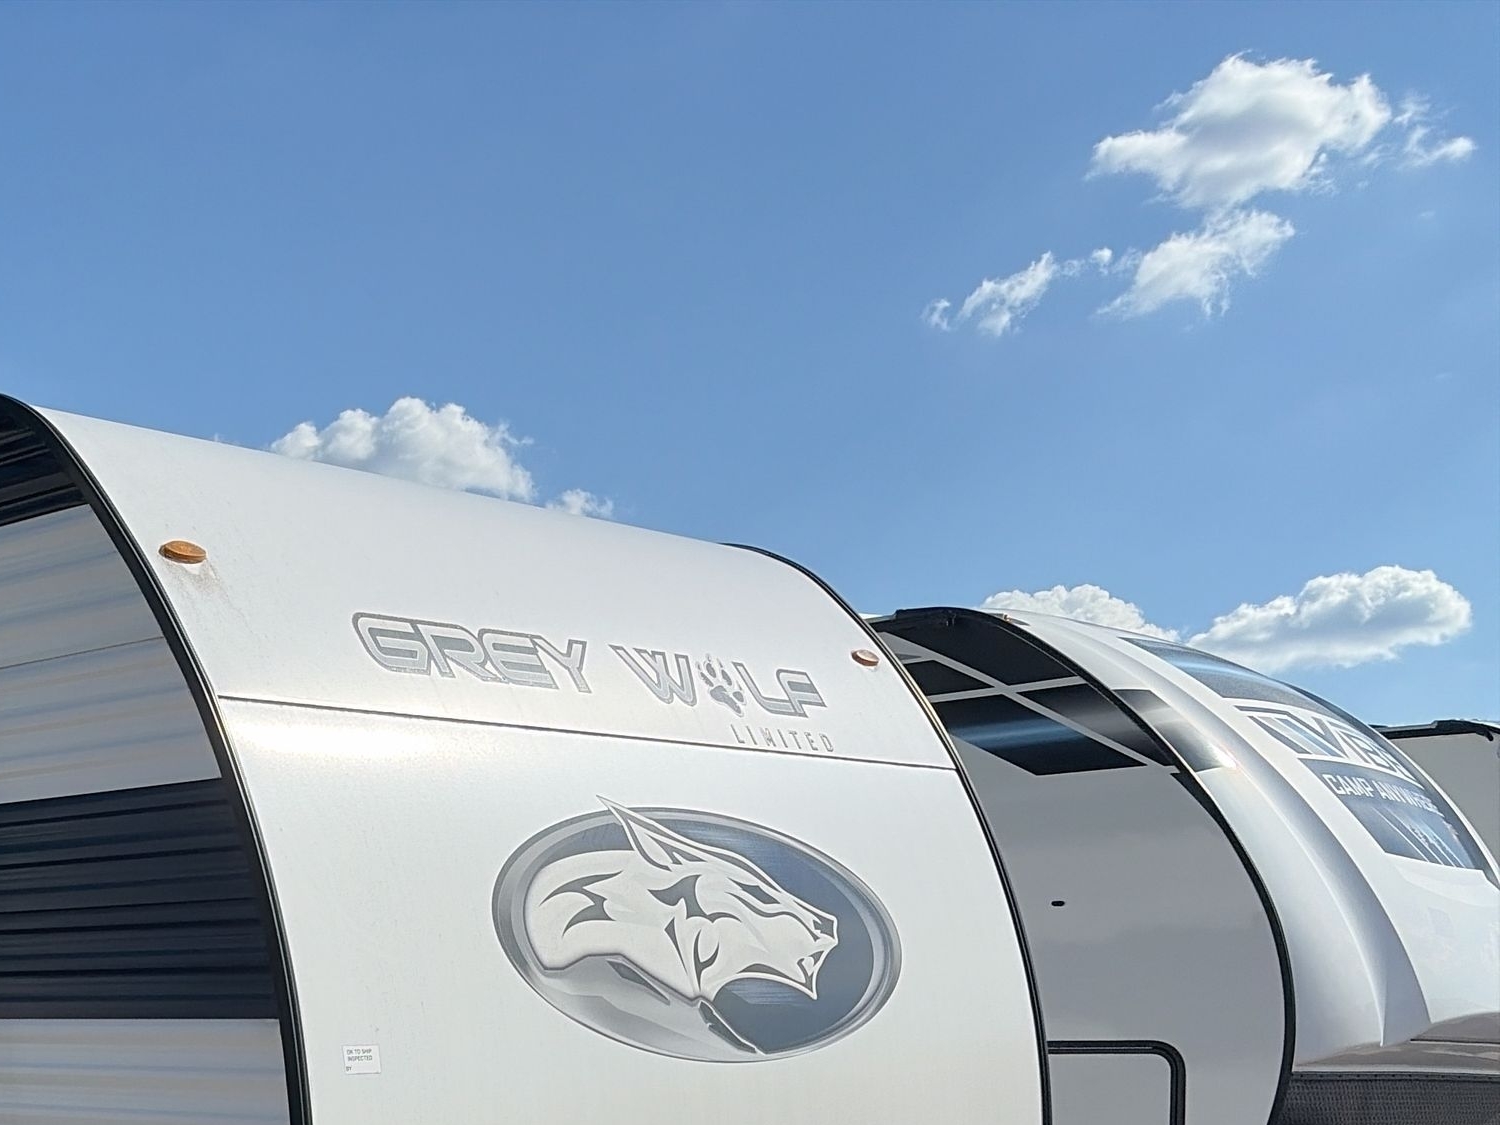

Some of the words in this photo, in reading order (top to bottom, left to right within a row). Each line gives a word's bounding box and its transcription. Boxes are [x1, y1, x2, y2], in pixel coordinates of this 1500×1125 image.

[352, 612, 592, 694] GREY
[731, 723, 835, 754] LIMITED
[1322, 773, 1374, 797] CAMP
